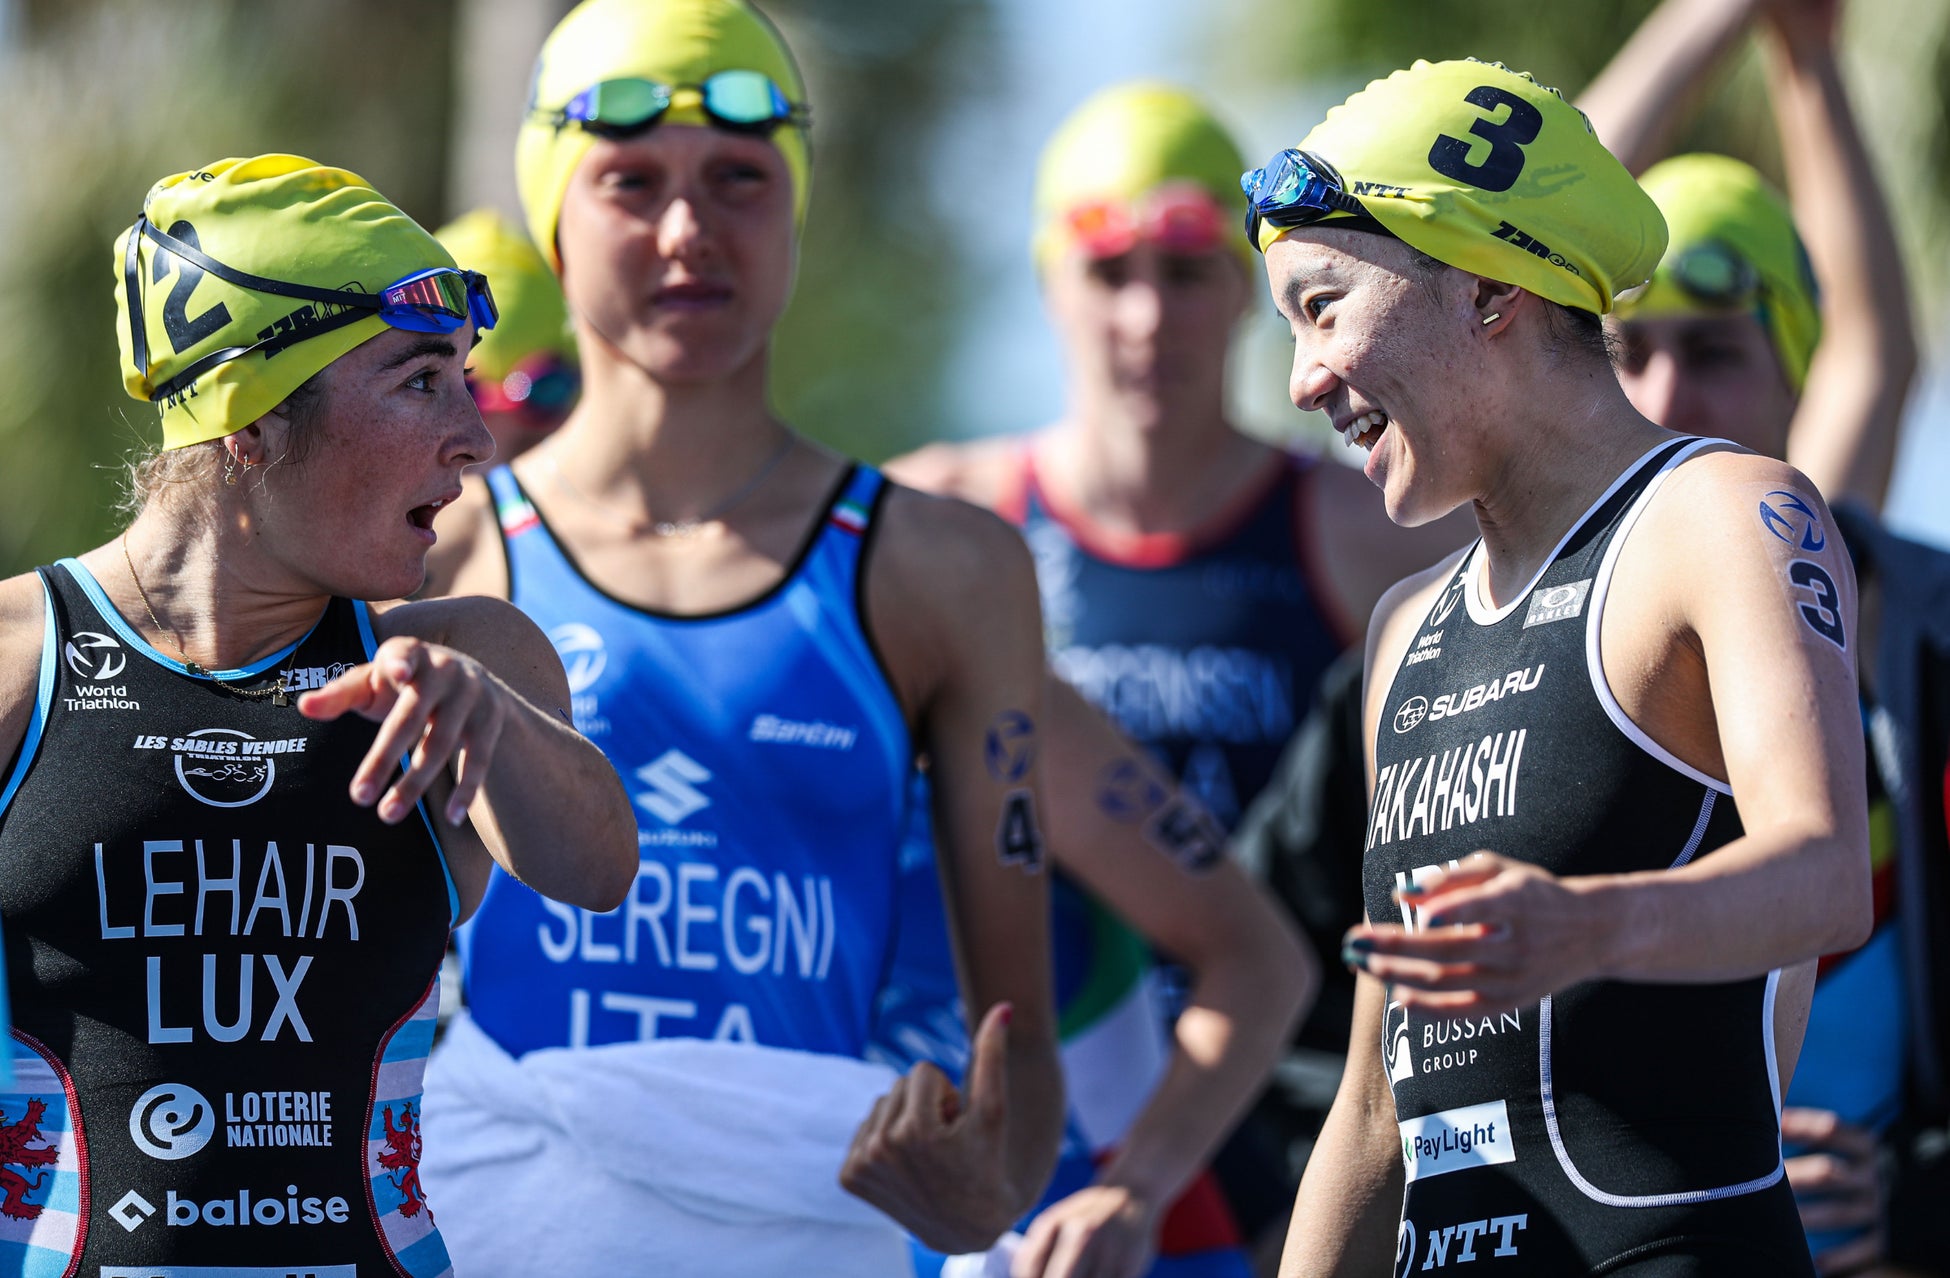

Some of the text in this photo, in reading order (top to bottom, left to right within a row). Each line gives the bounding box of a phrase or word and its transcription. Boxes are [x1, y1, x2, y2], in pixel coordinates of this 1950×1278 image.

[1428, 85, 1543, 193] 3
[1353, 181, 1413, 199] NTT
[167, 380, 199, 410] NTT
[1787, 559, 1847, 653] 3
[1417, 629, 1444, 650] World
[1406, 647, 1442, 668] Triathlon
[64, 698, 141, 712] Triathlon
[75, 684, 127, 698] World
[1428, 663, 1545, 722] SUBARU
[133, 735, 308, 756] LES SABLES VENDEE
[186, 752, 263, 763] TRIATHLON
[1365, 728, 1527, 853] TAKAHASHI
[999, 789, 1045, 875] 4
[94, 838, 366, 942] LEHAIR
[146, 953, 315, 1045] LUX
[1423, 1007, 1522, 1049] BUSSAN
[1422, 1049, 1478, 1074] GROUP
[225, 1091, 333, 1123] LOTERIE
[226, 1124, 333, 1147] NATIONALE
[1414, 1121, 1496, 1160] PayLight
[166, 1184, 351, 1227] baloise
[1421, 1213, 1529, 1272] NTT
